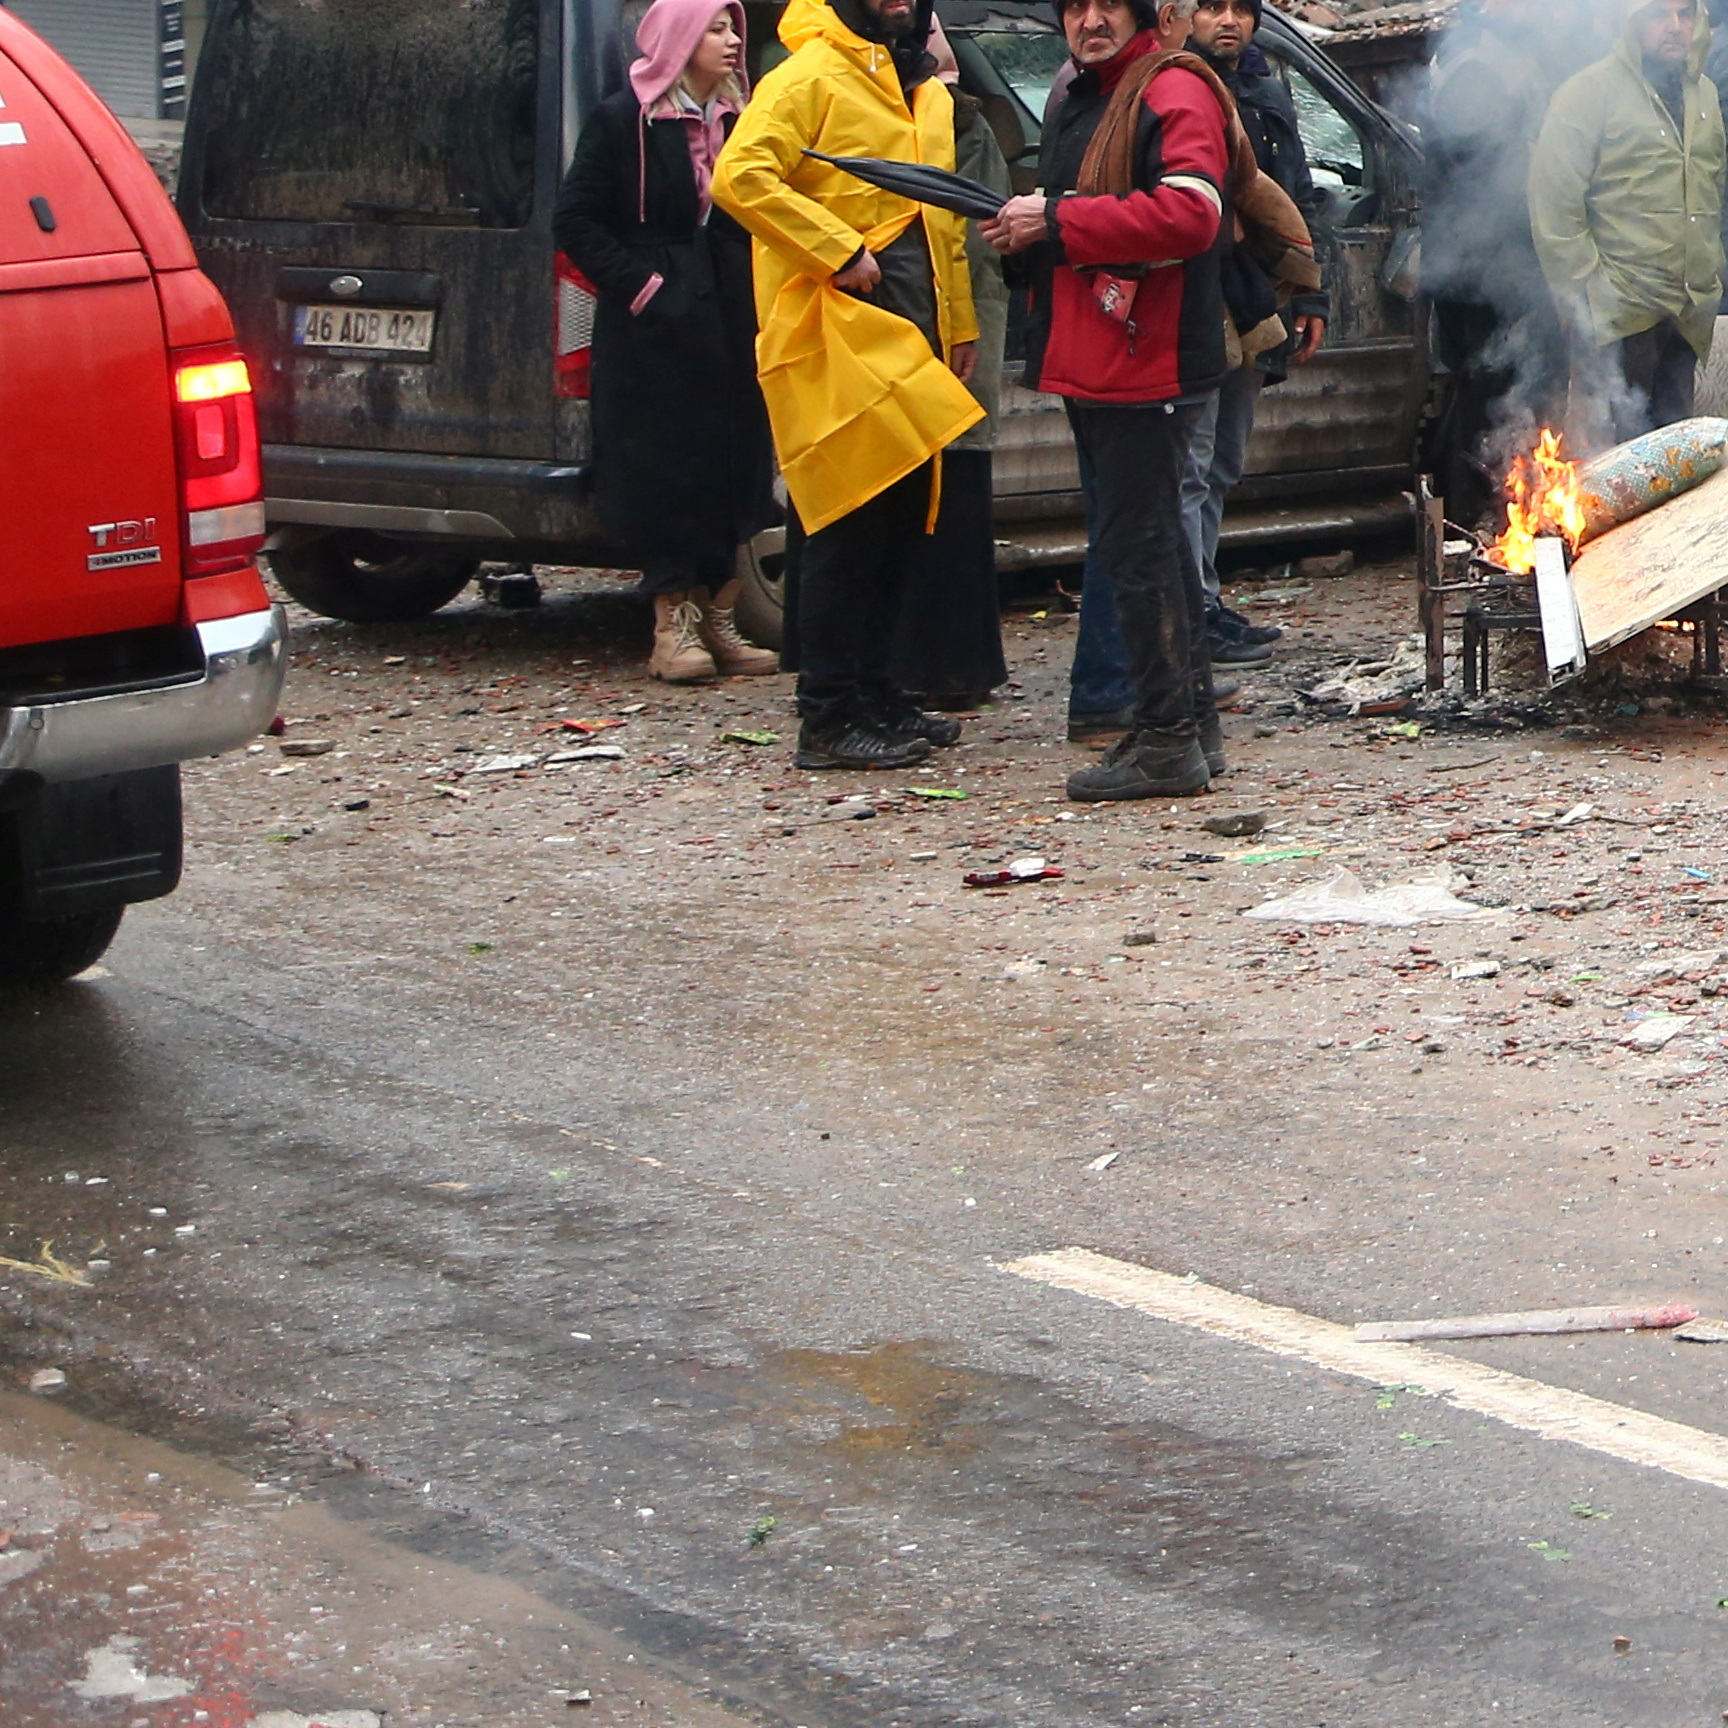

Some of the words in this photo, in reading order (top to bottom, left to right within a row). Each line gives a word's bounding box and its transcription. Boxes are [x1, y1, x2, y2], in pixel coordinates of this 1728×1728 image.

[306, 311, 332, 341] 46
[340, 313, 380, 344] ADB
[387, 314, 426, 347] 424
[88, 517, 156, 547] TDI
